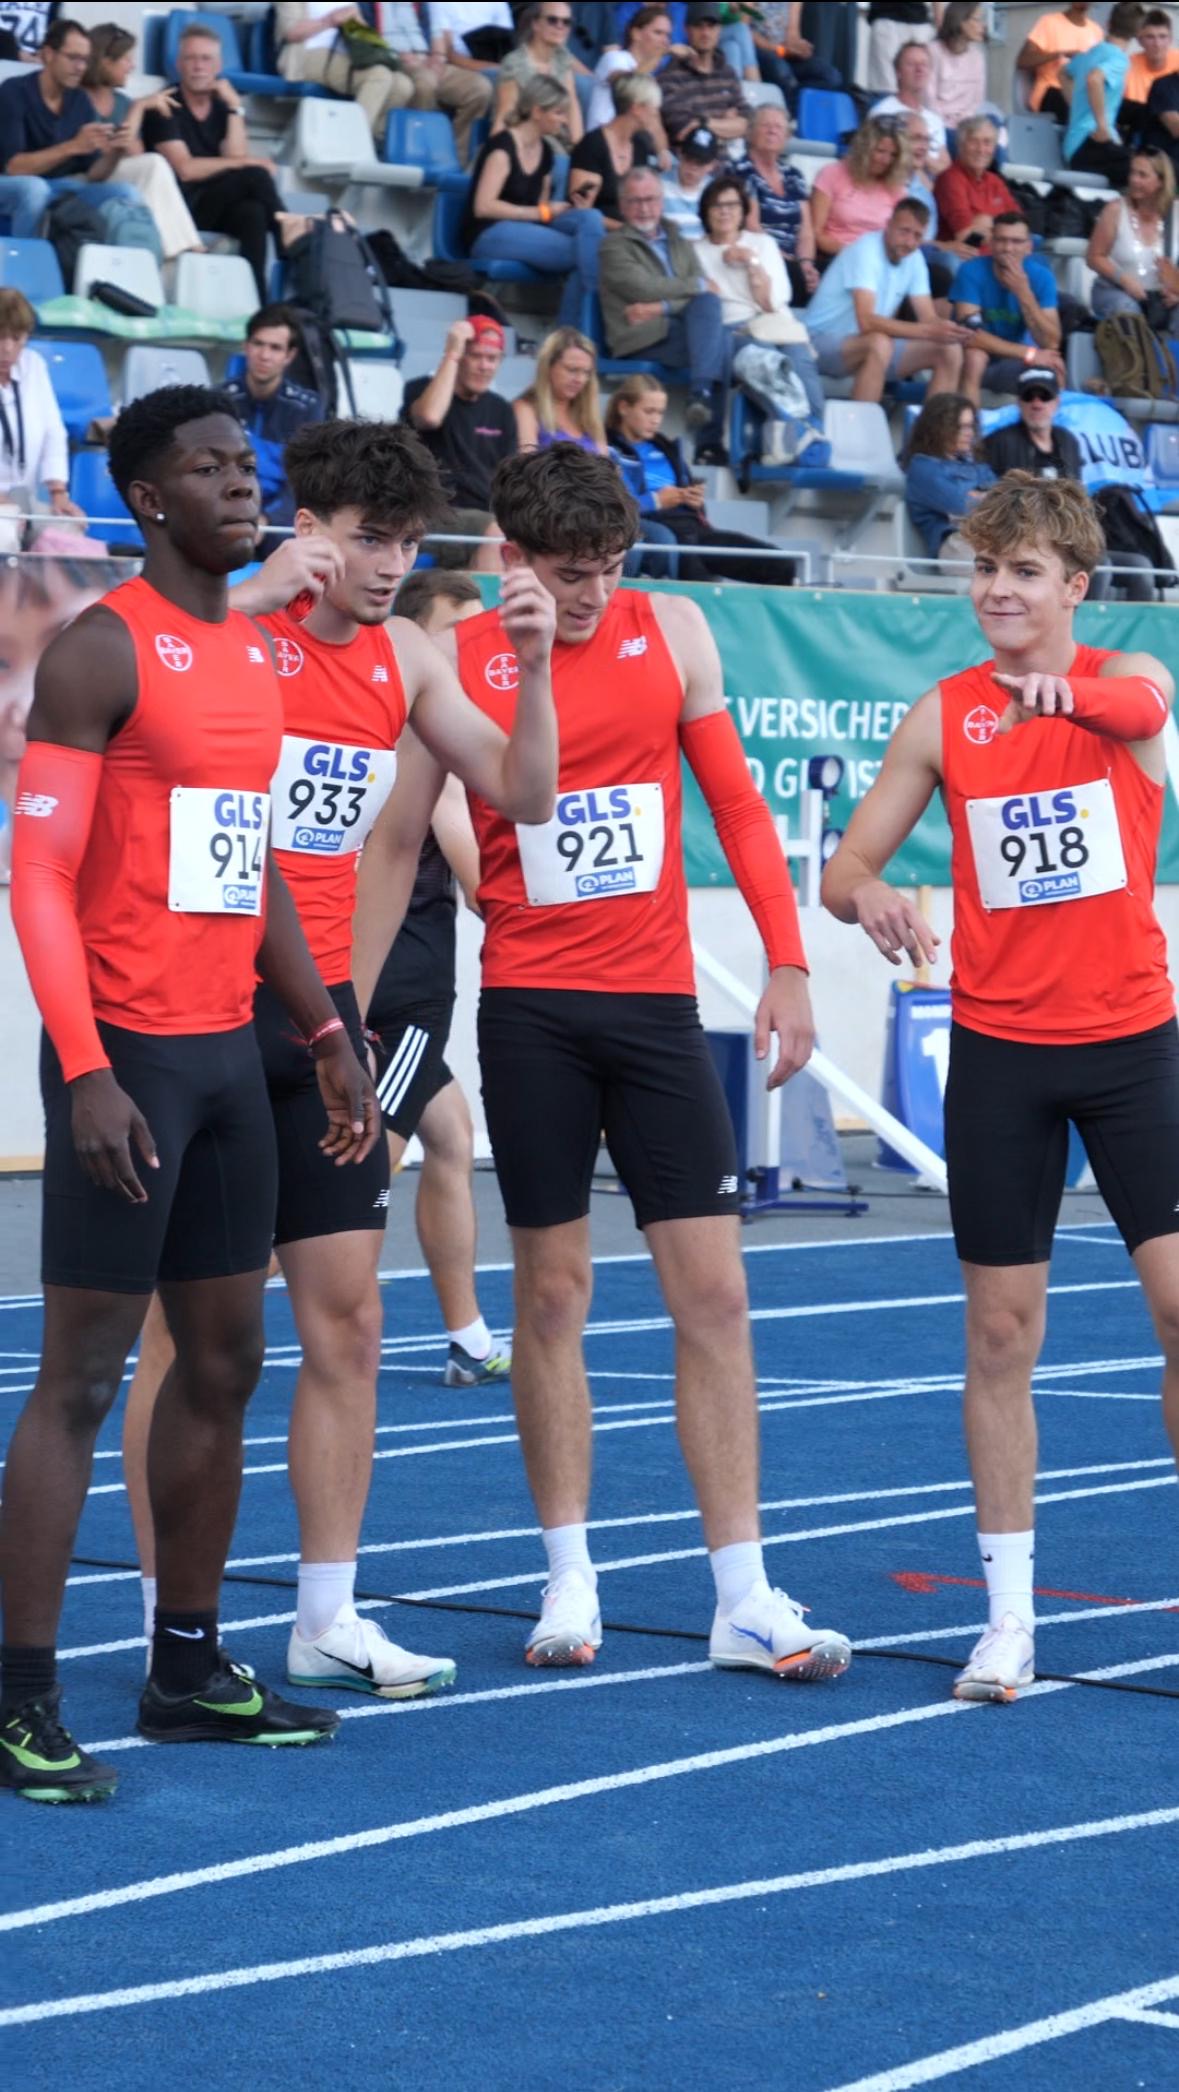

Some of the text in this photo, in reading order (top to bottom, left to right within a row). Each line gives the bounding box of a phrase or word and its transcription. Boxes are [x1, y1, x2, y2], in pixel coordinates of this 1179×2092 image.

[1080, 432, 1142, 469] LUB
[287, 778, 367, 828] 933
[556, 823, 645, 872] 921
[1000, 826, 1090, 877] 918
